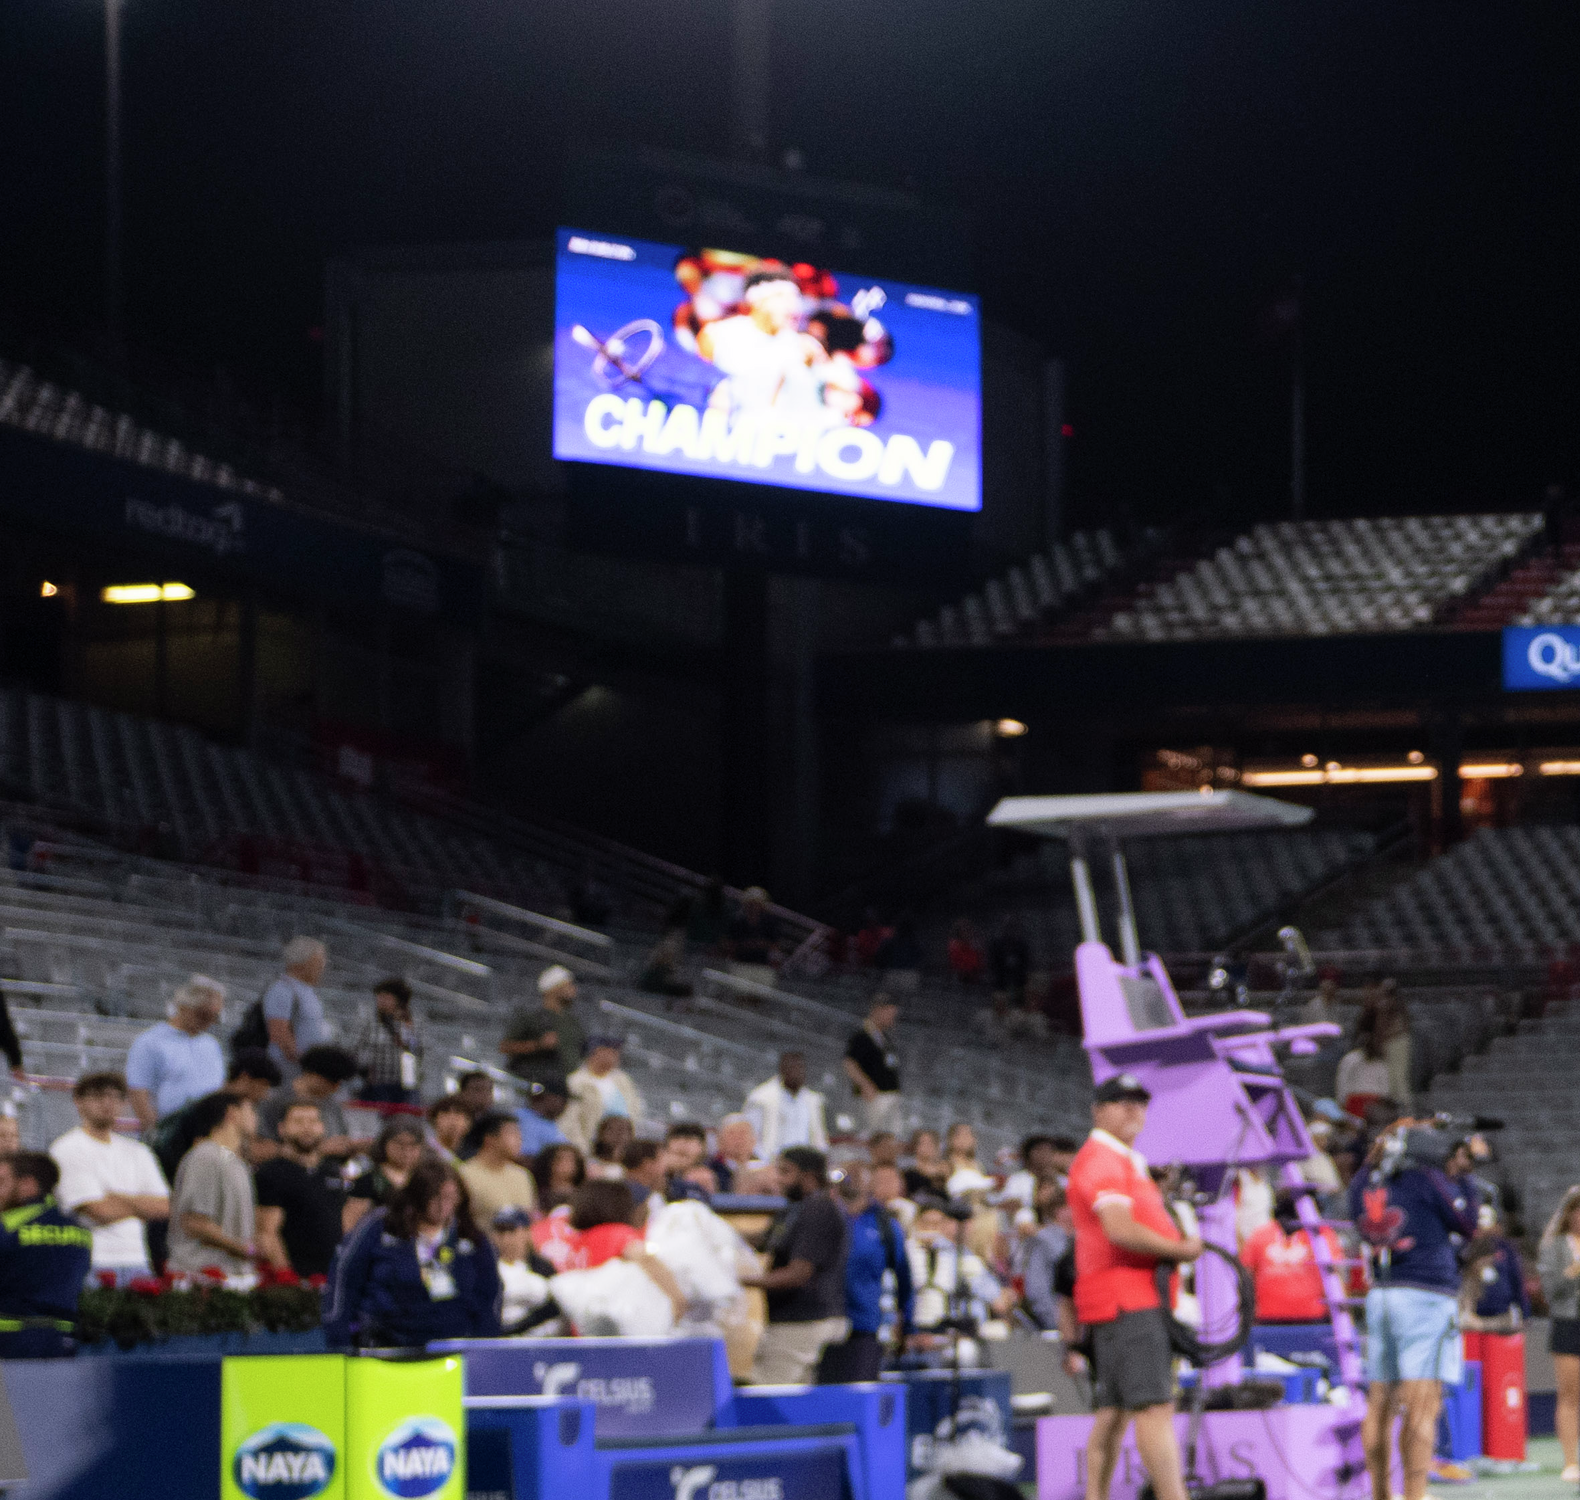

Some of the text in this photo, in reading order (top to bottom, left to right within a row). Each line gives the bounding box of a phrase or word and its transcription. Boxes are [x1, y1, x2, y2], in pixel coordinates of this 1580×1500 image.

[584, 394, 955, 491] CHAMPION
[240, 1450, 328, 1486] NAYA
[382, 1445, 450, 1482] NAYA
